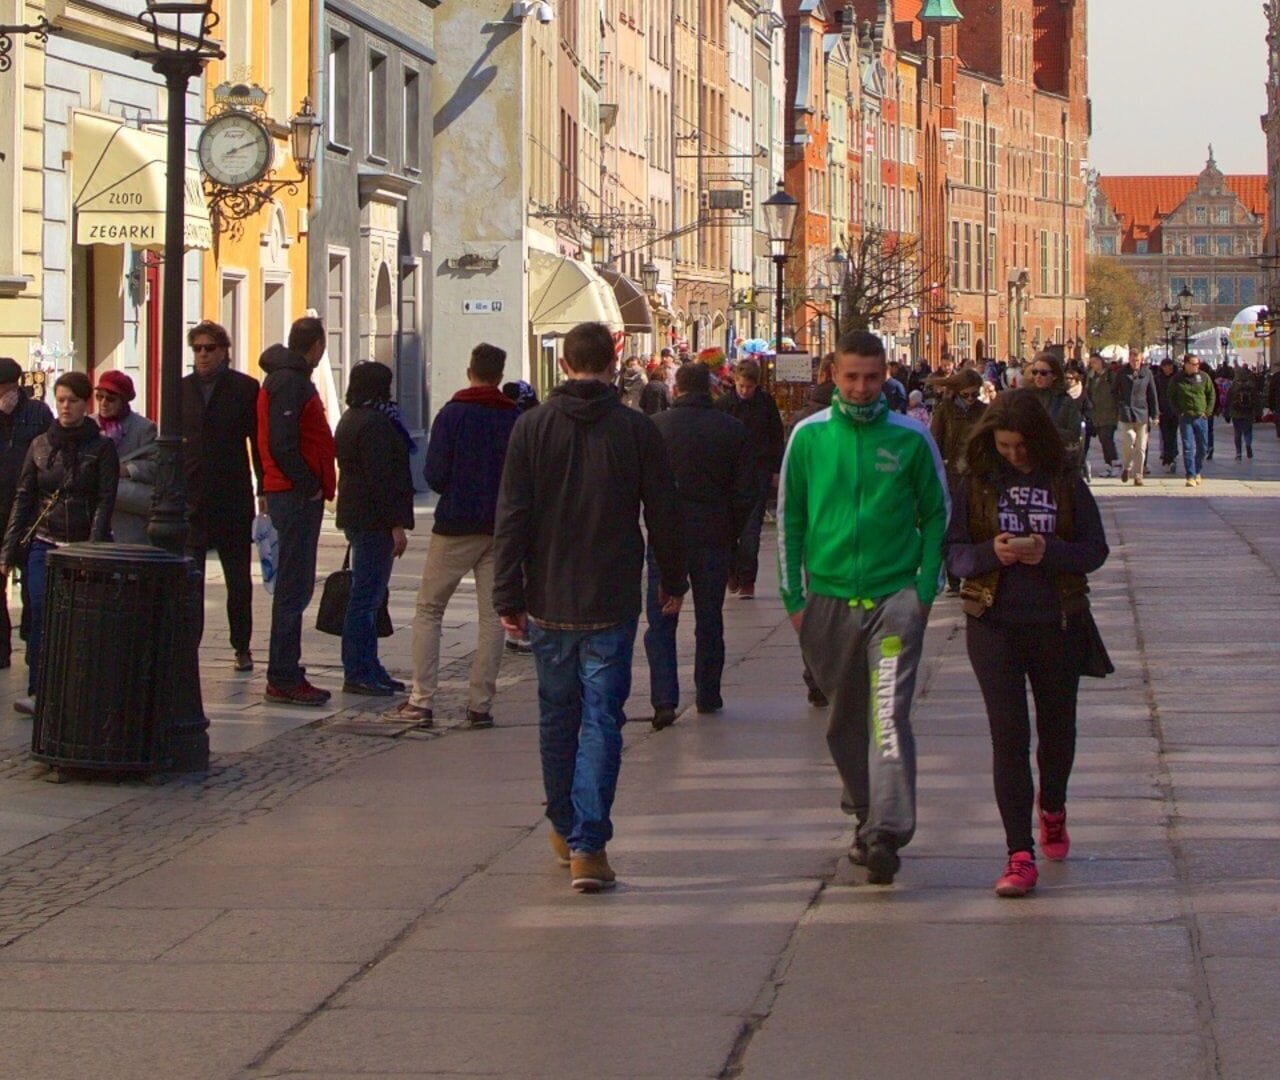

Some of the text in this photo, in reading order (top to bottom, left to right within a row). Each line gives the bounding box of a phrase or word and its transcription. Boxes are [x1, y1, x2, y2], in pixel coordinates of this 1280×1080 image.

[109, 192, 142, 205] ZŁOTO
[90, 225, 154, 238] ZEGARKI
[877, 655, 899, 758] UNIVERSITY
